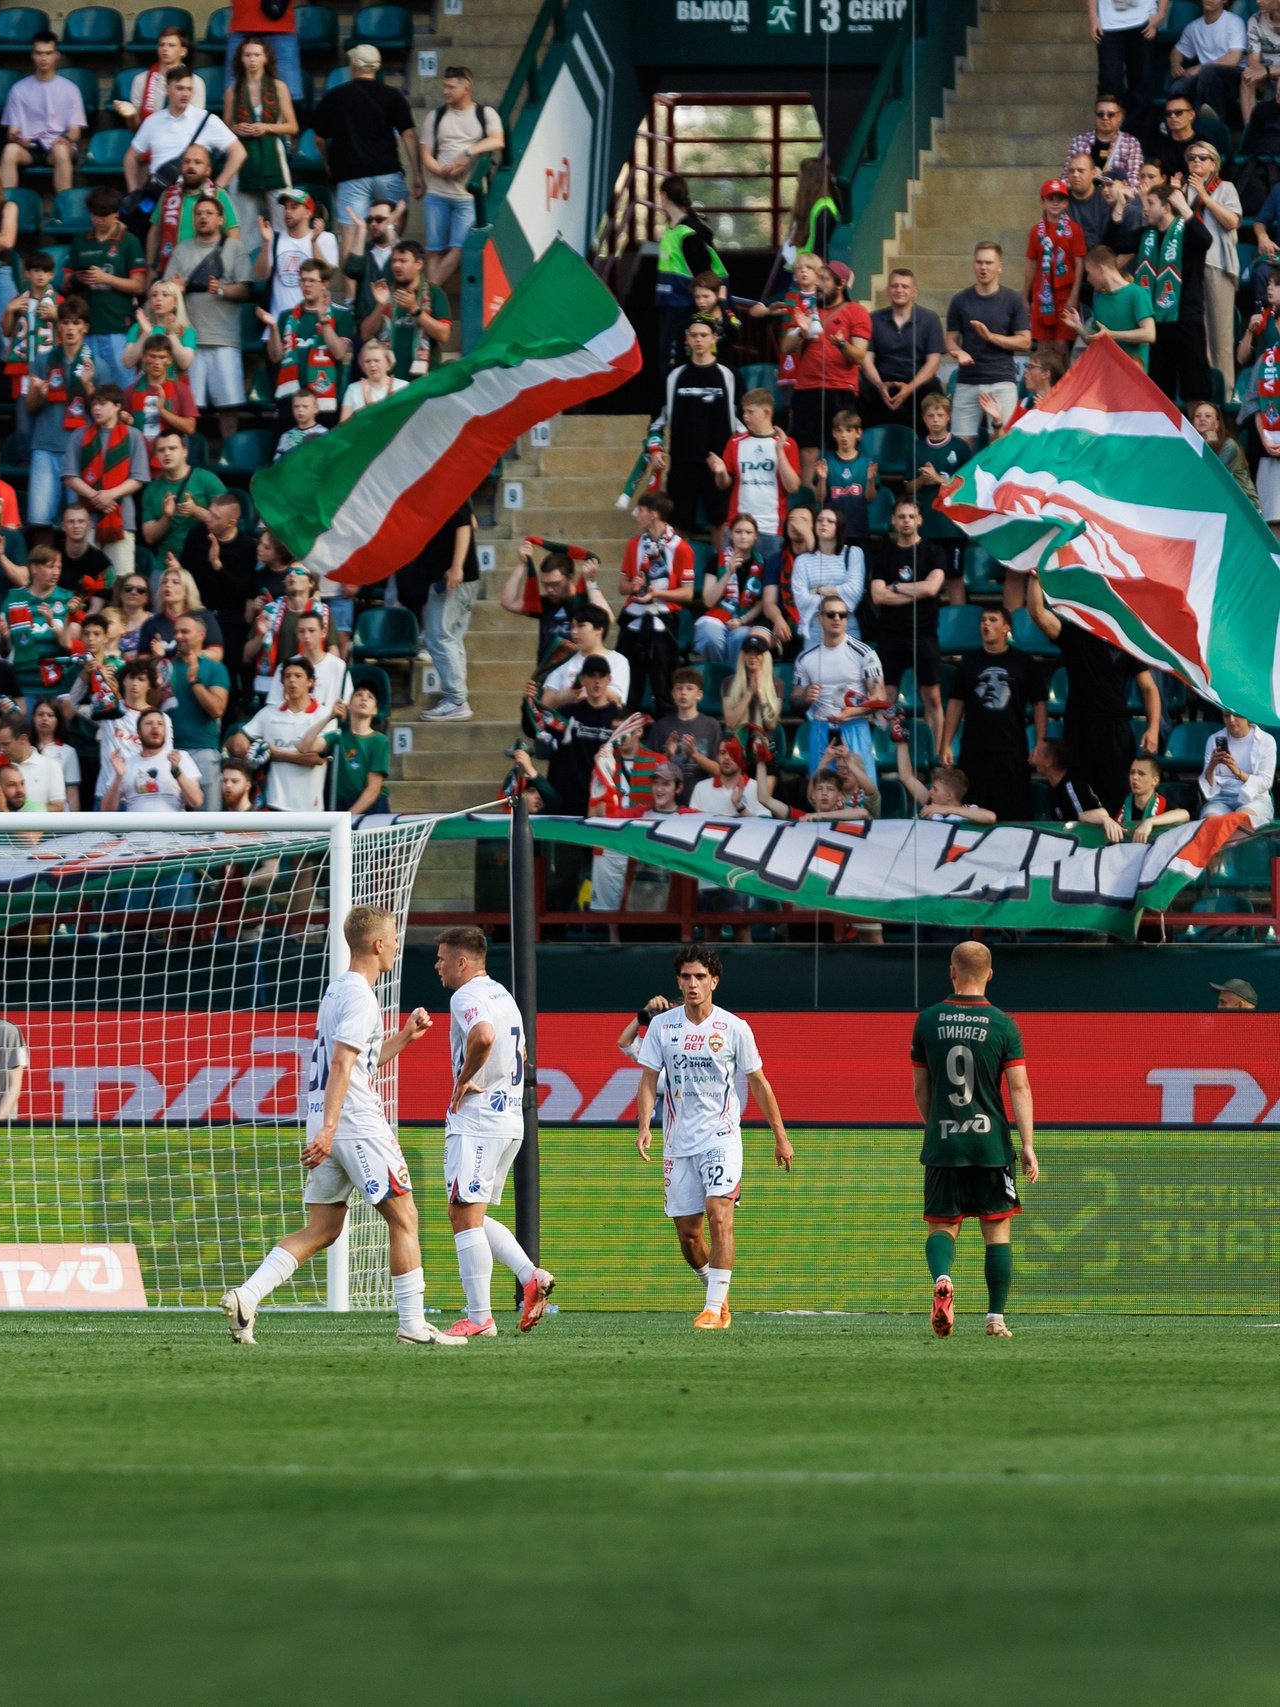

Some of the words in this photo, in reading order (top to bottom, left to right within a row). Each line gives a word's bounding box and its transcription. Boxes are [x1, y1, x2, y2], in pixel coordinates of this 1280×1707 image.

[676, 0, 750, 23] ВЫХОД
[819, 0, 841, 31] 3
[532, 427, 548, 440] 10
[508, 488, 517, 502] 9
[481, 551, 490, 565] 8
[427, 673, 435, 686] 6
[399, 734, 407, 747] 5
[938, 1013, 989, 1024] BetBoom
[684, 1034, 706, 1042] FON
[937, 1025, 988, 1042] ПИНЯЕВ
[684, 1043, 705, 1051] BET
[510, 1026, 523, 1086] 3
[689, 1060, 713, 1068] ЗНАК
[946, 1045, 974, 1107] 9
[355, 1144, 372, 1179] РОССЕТИ
[474, 1146, 485, 1179] РОССЕТИ
[708, 1165, 724, 1186] 52
[1140, 1220, 1280, 1262] ЗНА
